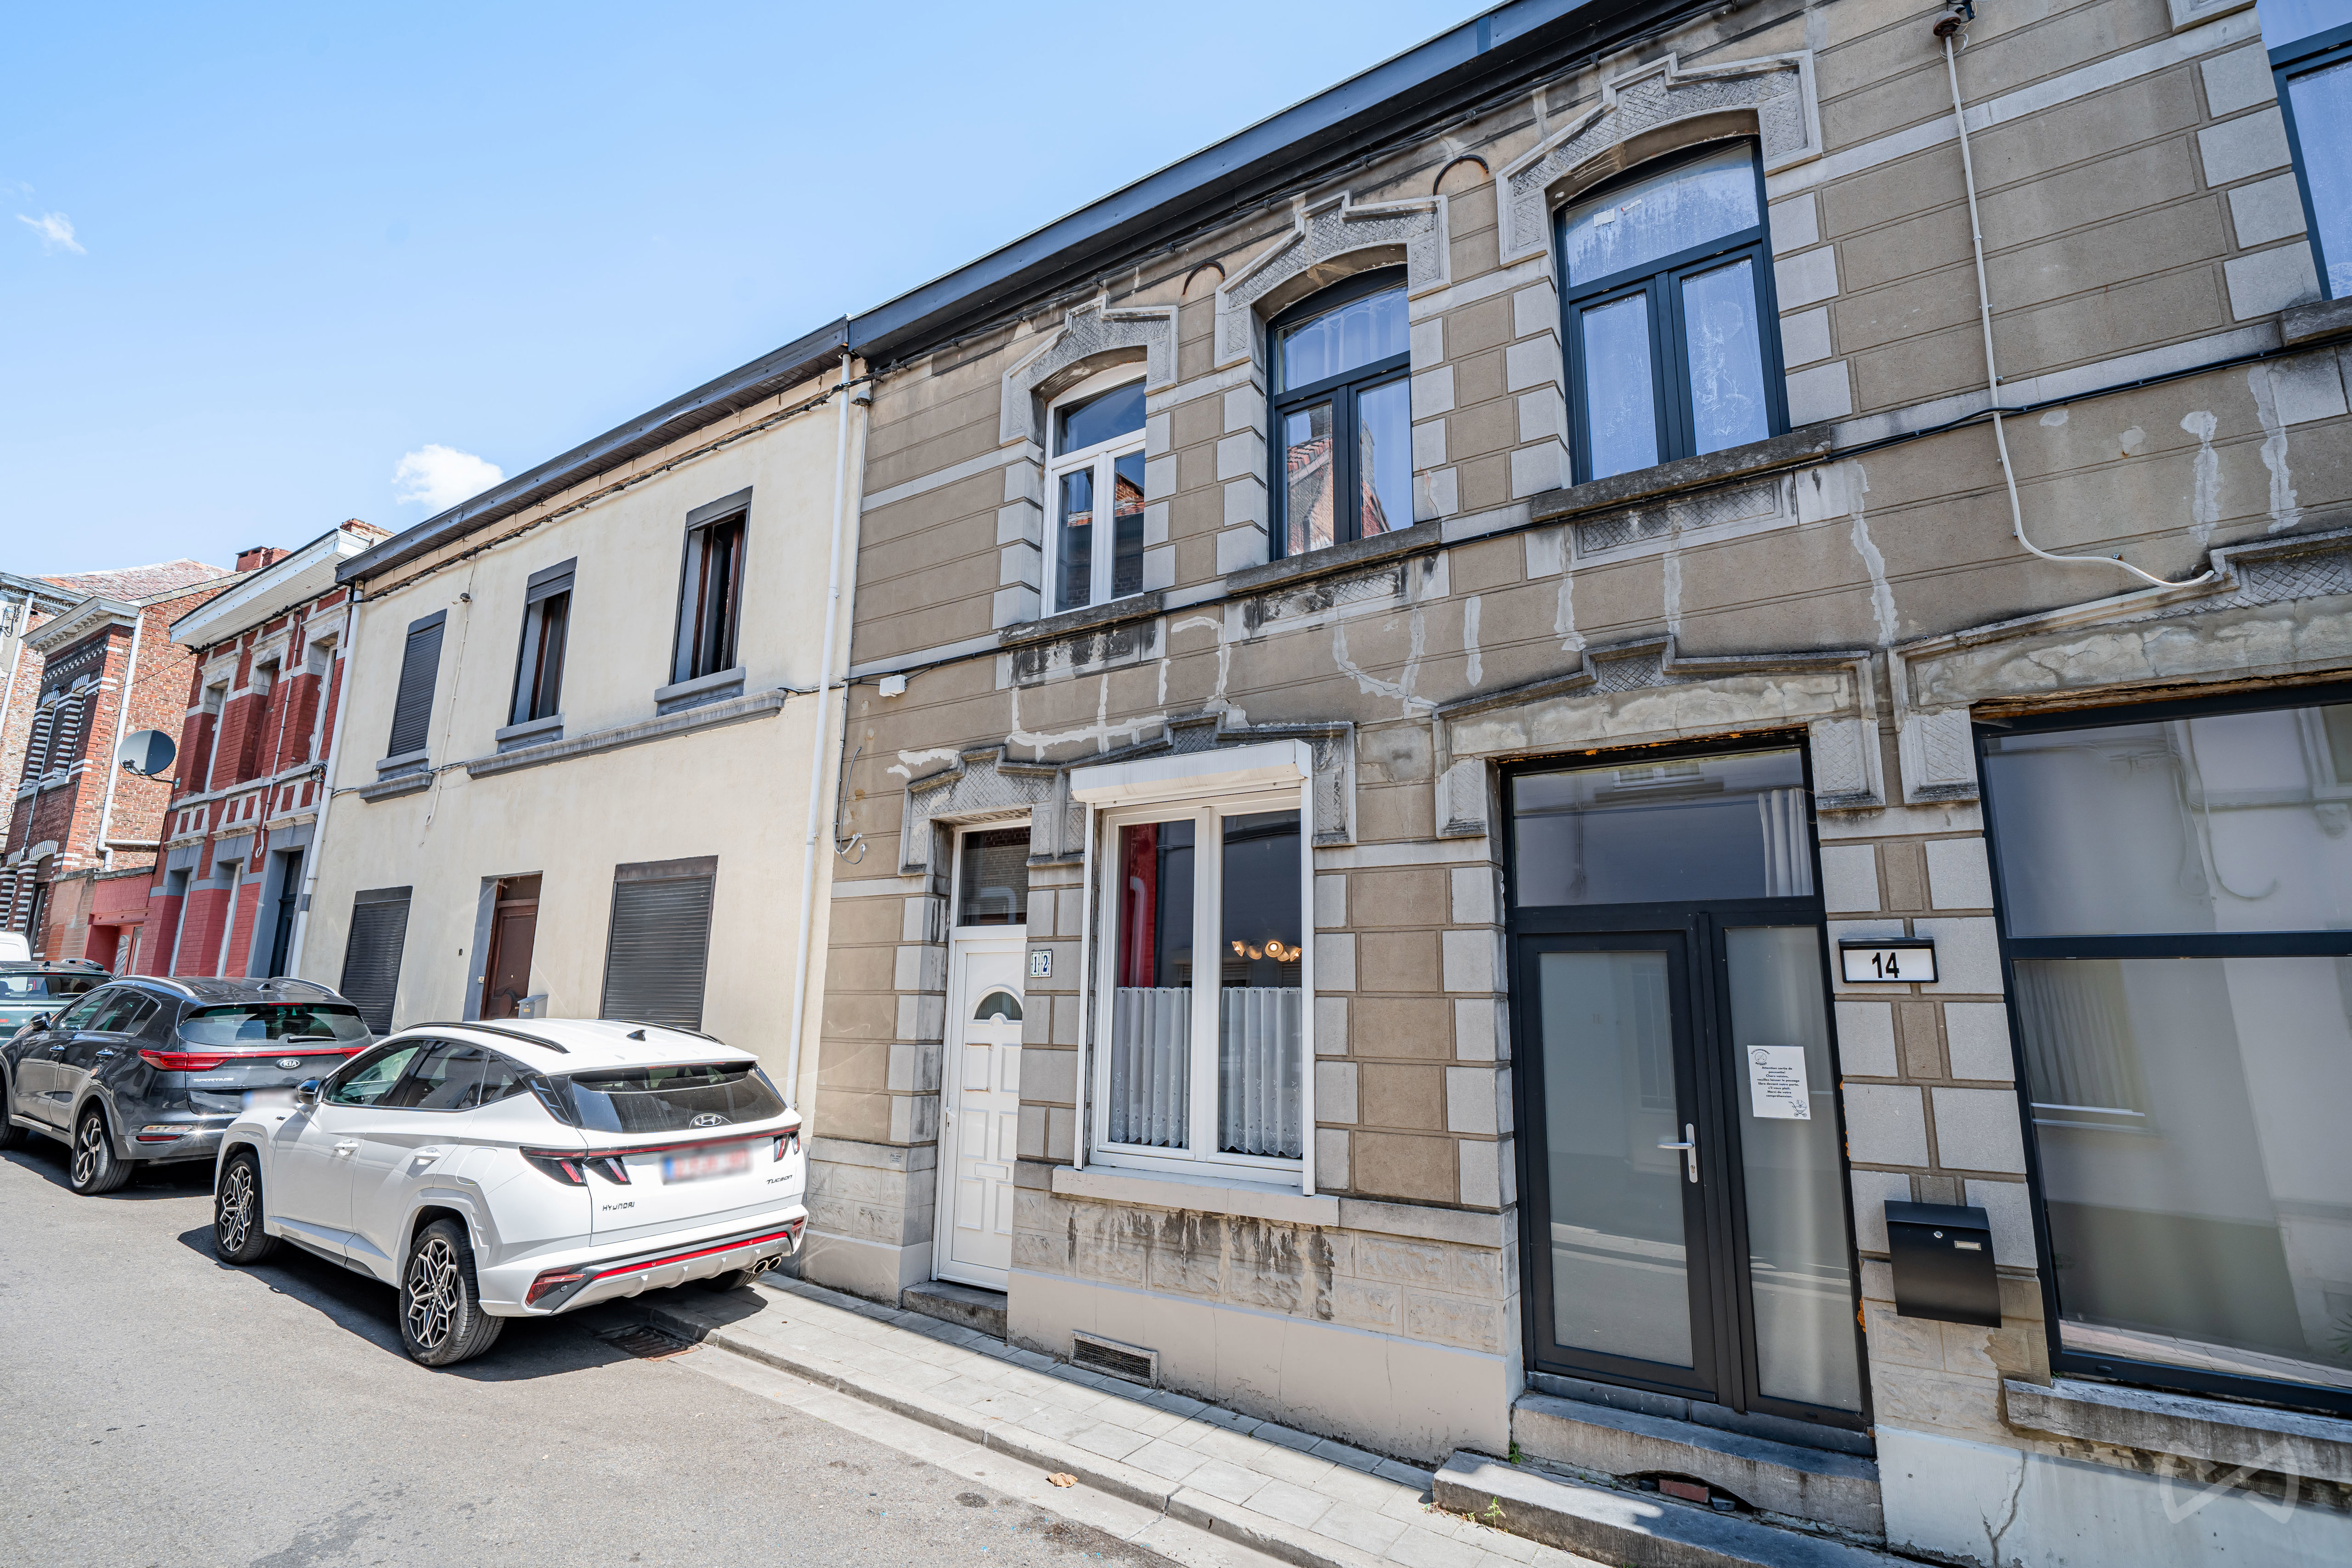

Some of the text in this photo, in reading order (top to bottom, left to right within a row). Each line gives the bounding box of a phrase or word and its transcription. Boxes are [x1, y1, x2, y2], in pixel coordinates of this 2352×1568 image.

[1034, 955, 1048, 973] 12
[1872, 952, 1900, 979] 14
[766, 1175, 792, 1184] TUCSON
[603, 1201, 635, 1211] HYUNDAI
